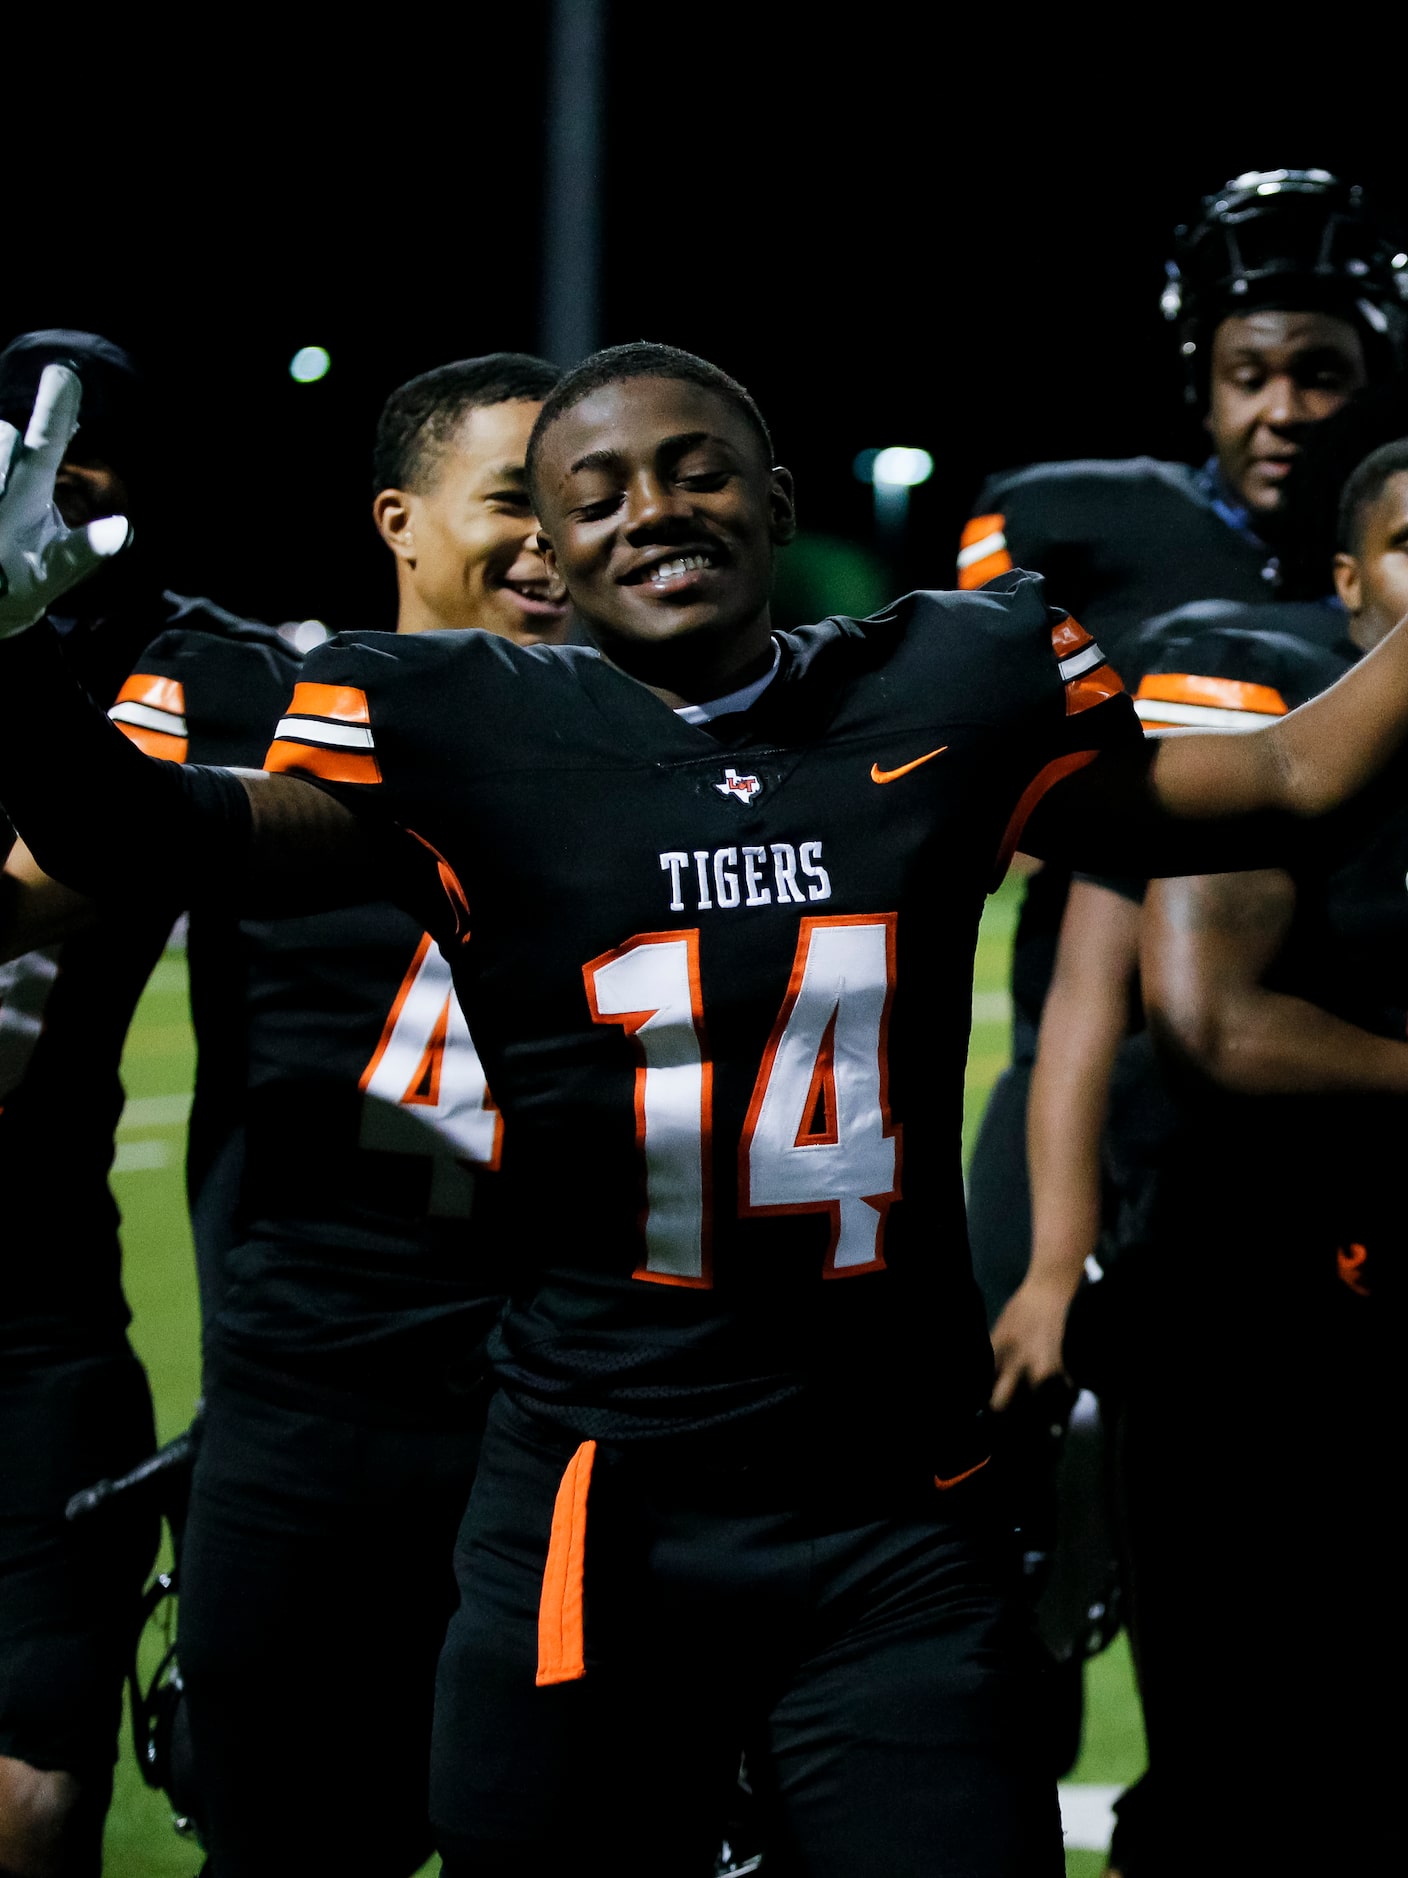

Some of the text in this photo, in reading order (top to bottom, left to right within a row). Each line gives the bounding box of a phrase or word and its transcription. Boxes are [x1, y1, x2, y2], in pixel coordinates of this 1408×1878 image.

[660, 841, 832, 911] TIGERS
[357, 929, 507, 1221] 4
[582, 912, 903, 1288] 14
